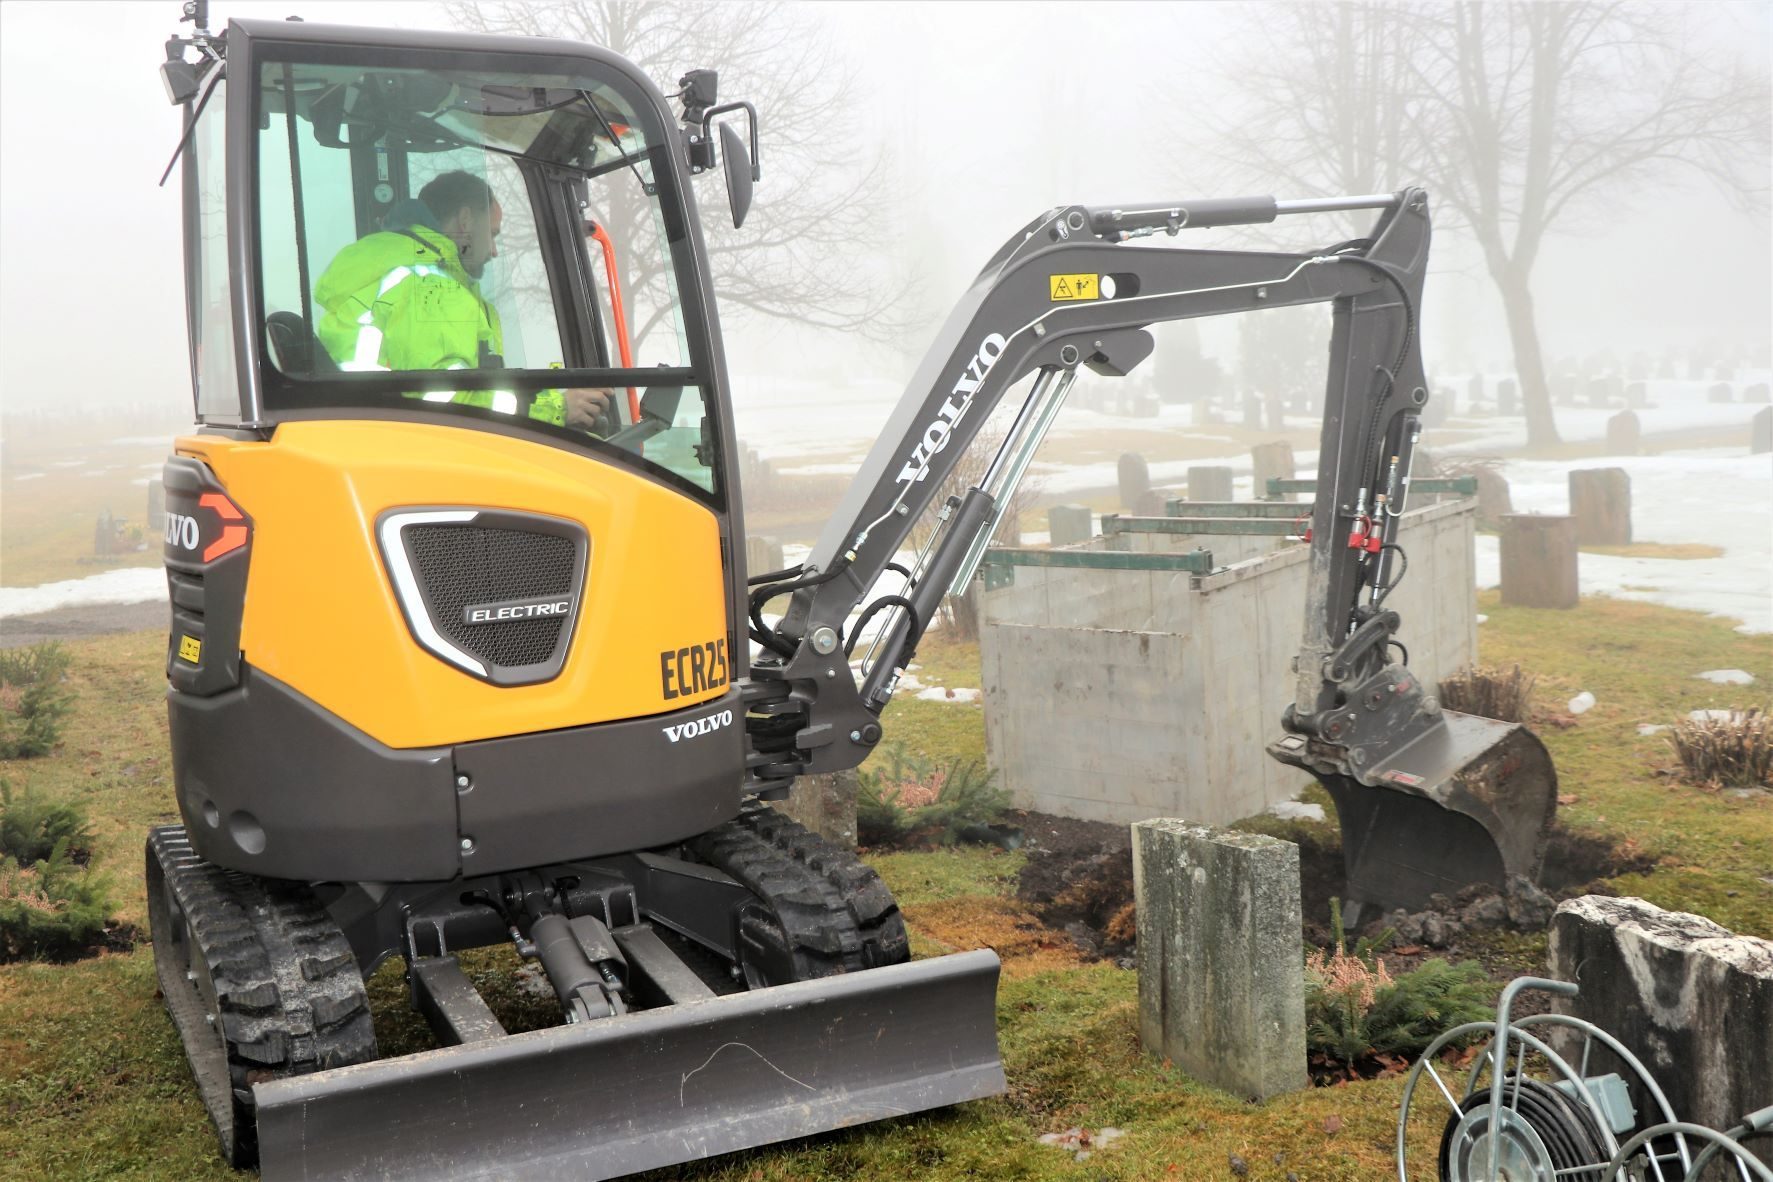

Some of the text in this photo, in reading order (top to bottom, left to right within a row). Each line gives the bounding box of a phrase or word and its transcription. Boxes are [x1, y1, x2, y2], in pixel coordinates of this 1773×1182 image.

[896, 332, 1006, 485] VOLVO
[165, 511, 200, 551] LVO
[472, 601, 569, 622] ELECTRIC
[660, 638, 727, 700] ECR25
[662, 709, 733, 743] VOLVO
